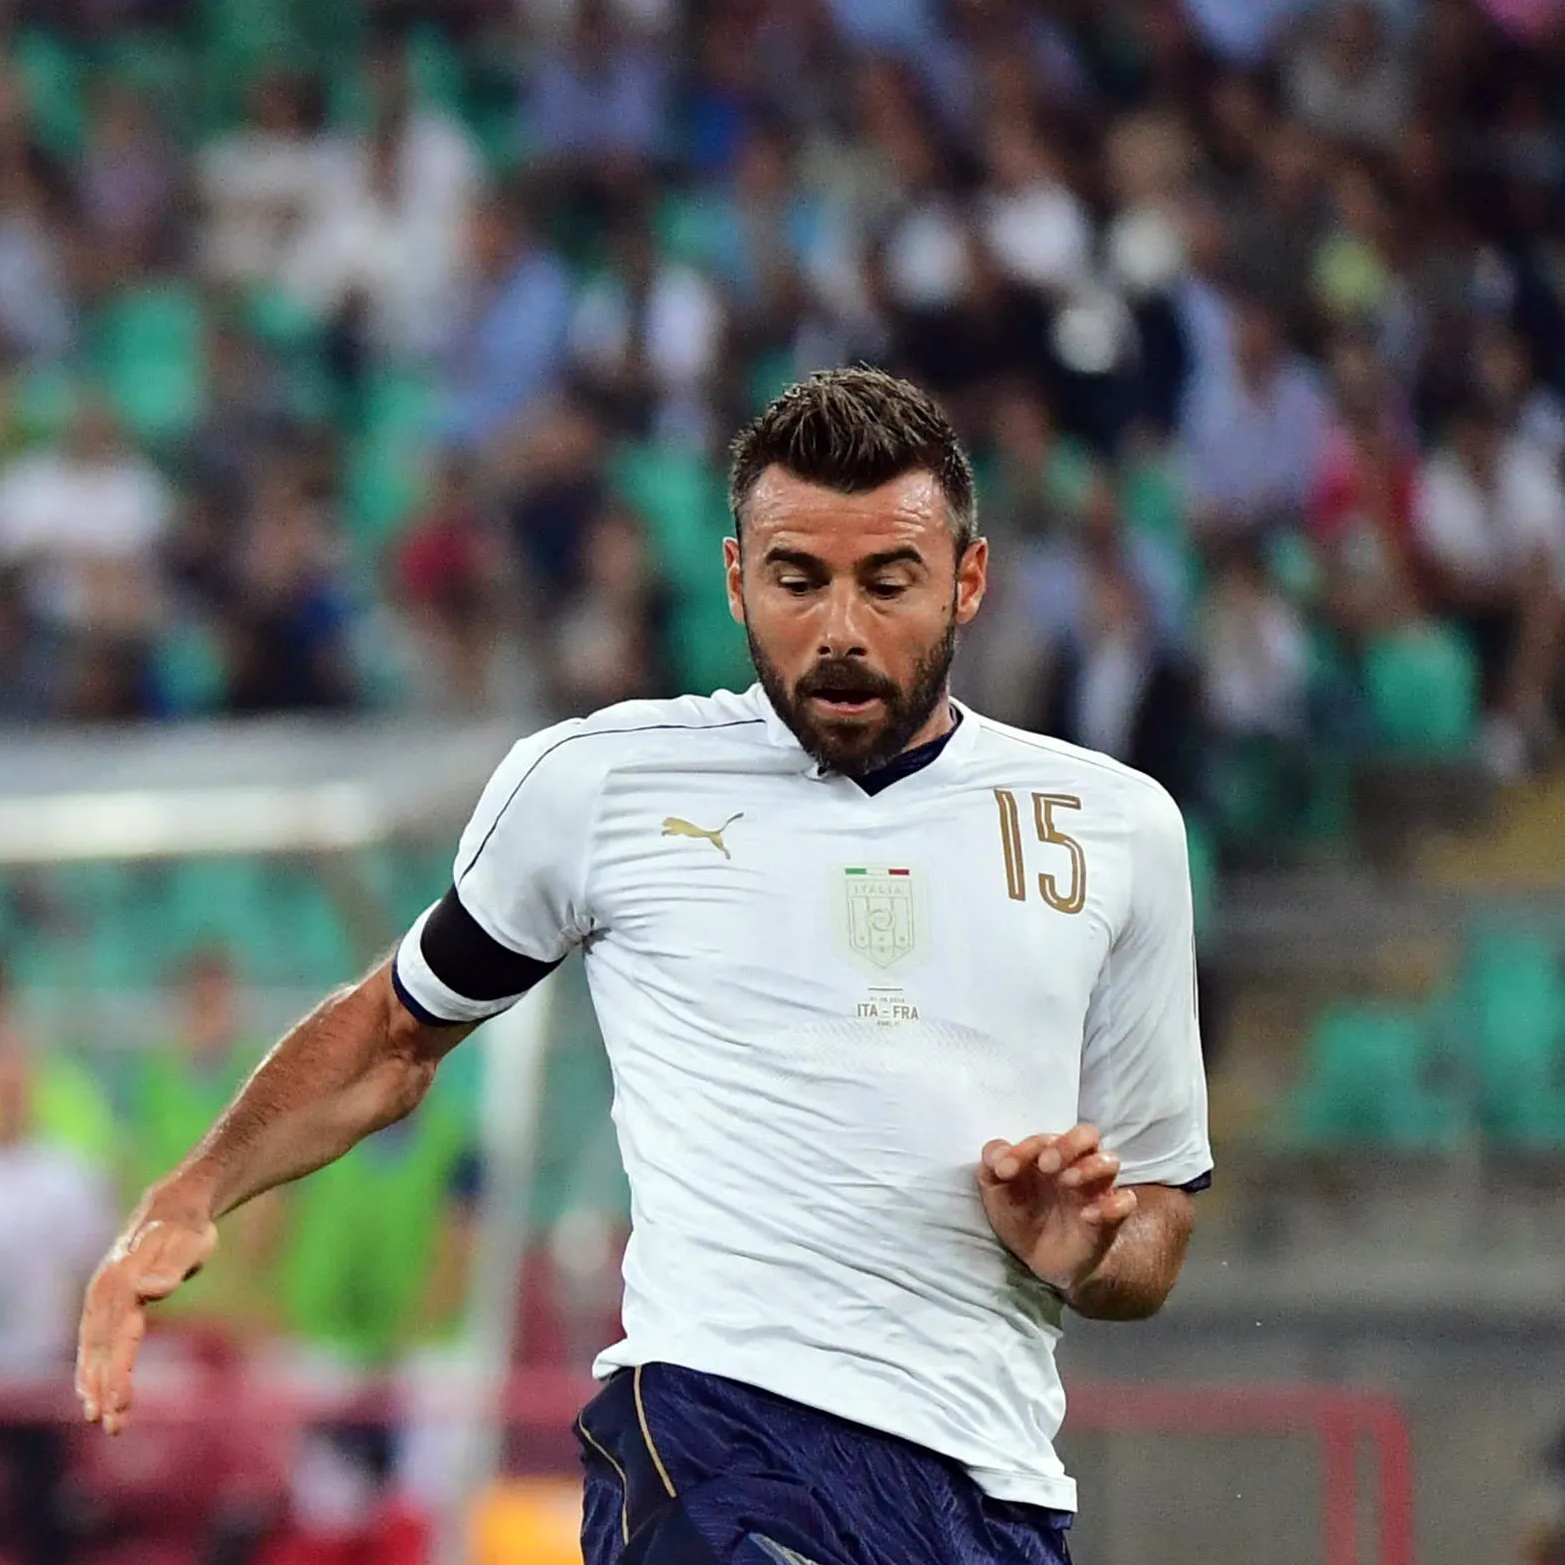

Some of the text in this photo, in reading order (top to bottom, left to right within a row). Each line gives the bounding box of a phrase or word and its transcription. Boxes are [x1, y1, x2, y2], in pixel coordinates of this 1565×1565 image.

[993, 788, 1087, 915] 15
[853, 884, 903, 896] ITALIA
[857, 1003, 879, 1017] ITA
[893, 1005, 920, 1020] FRA
